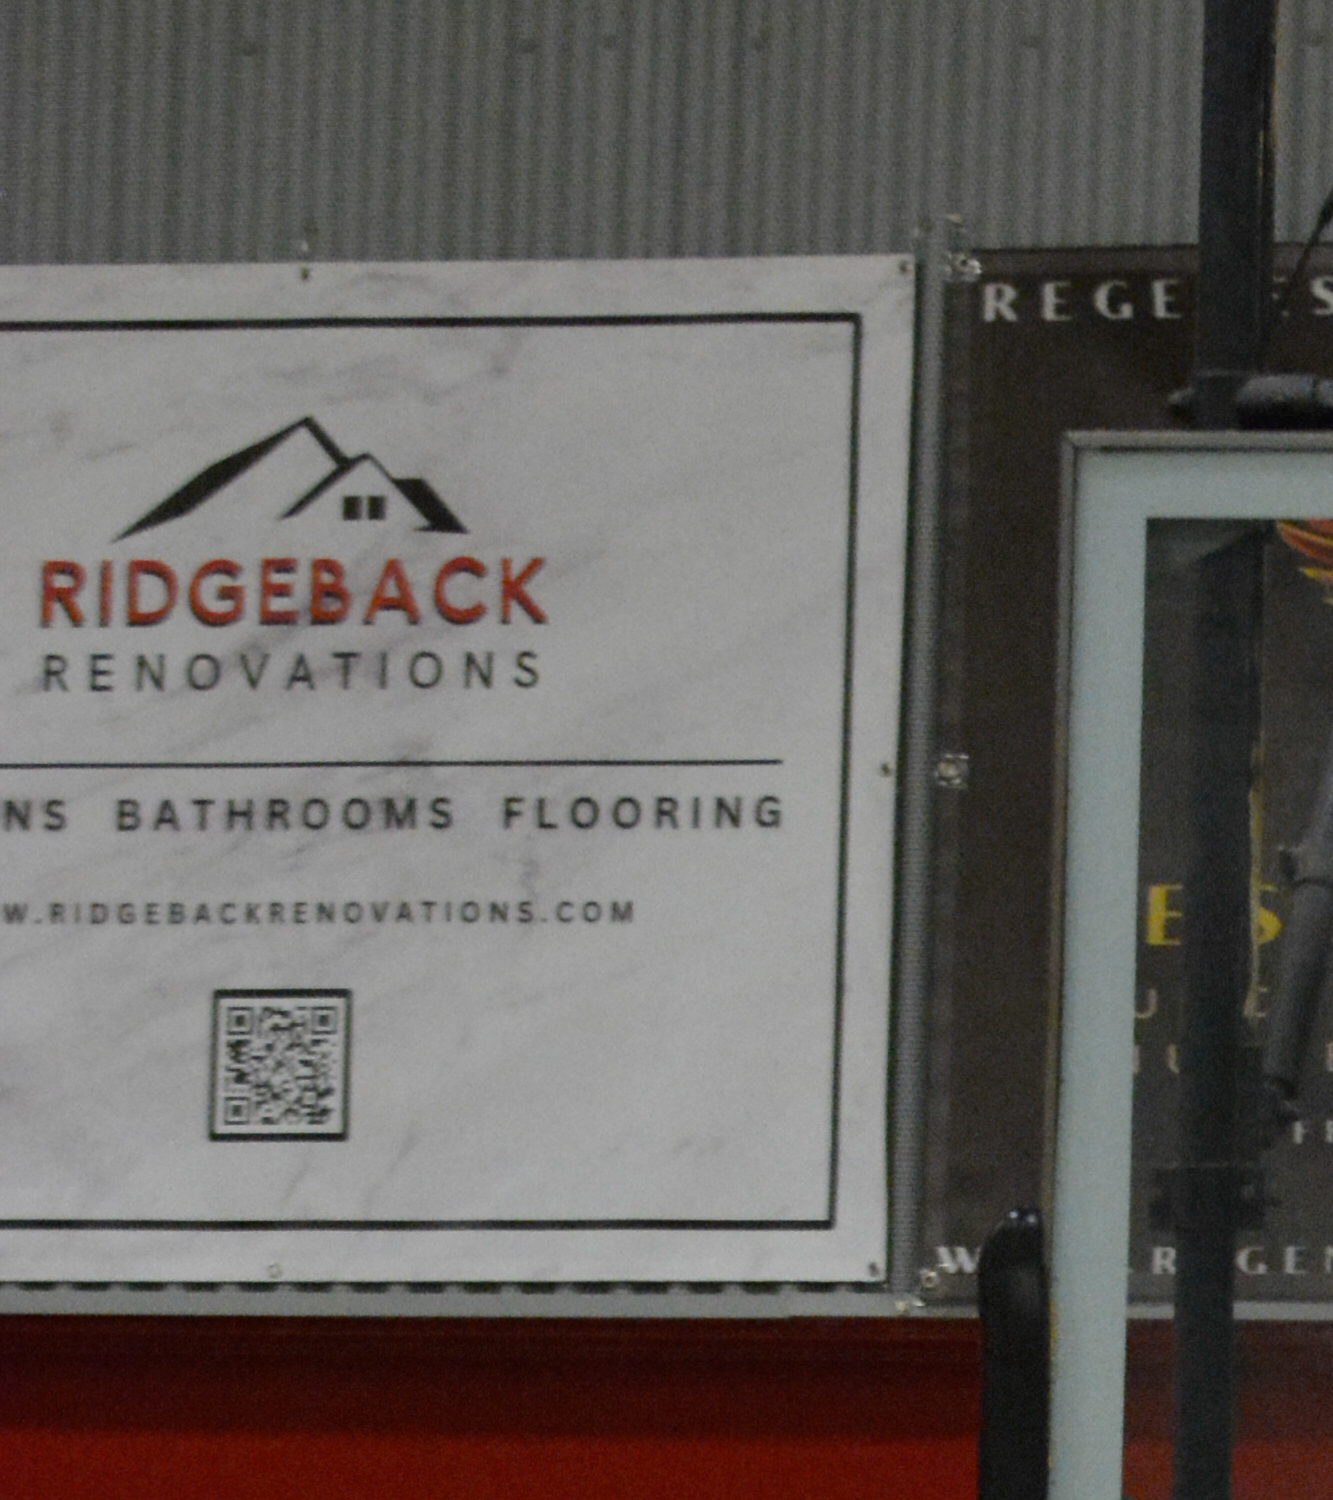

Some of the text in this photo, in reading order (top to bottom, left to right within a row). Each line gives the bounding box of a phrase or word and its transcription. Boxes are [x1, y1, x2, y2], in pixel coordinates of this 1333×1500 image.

[37, 555, 549, 628] RIDGEBACK
[41, 649, 542, 693] RENOVATIONS
[115, 797, 456, 832] BATHROOMS
[503, 796, 785, 830] FLOORING
